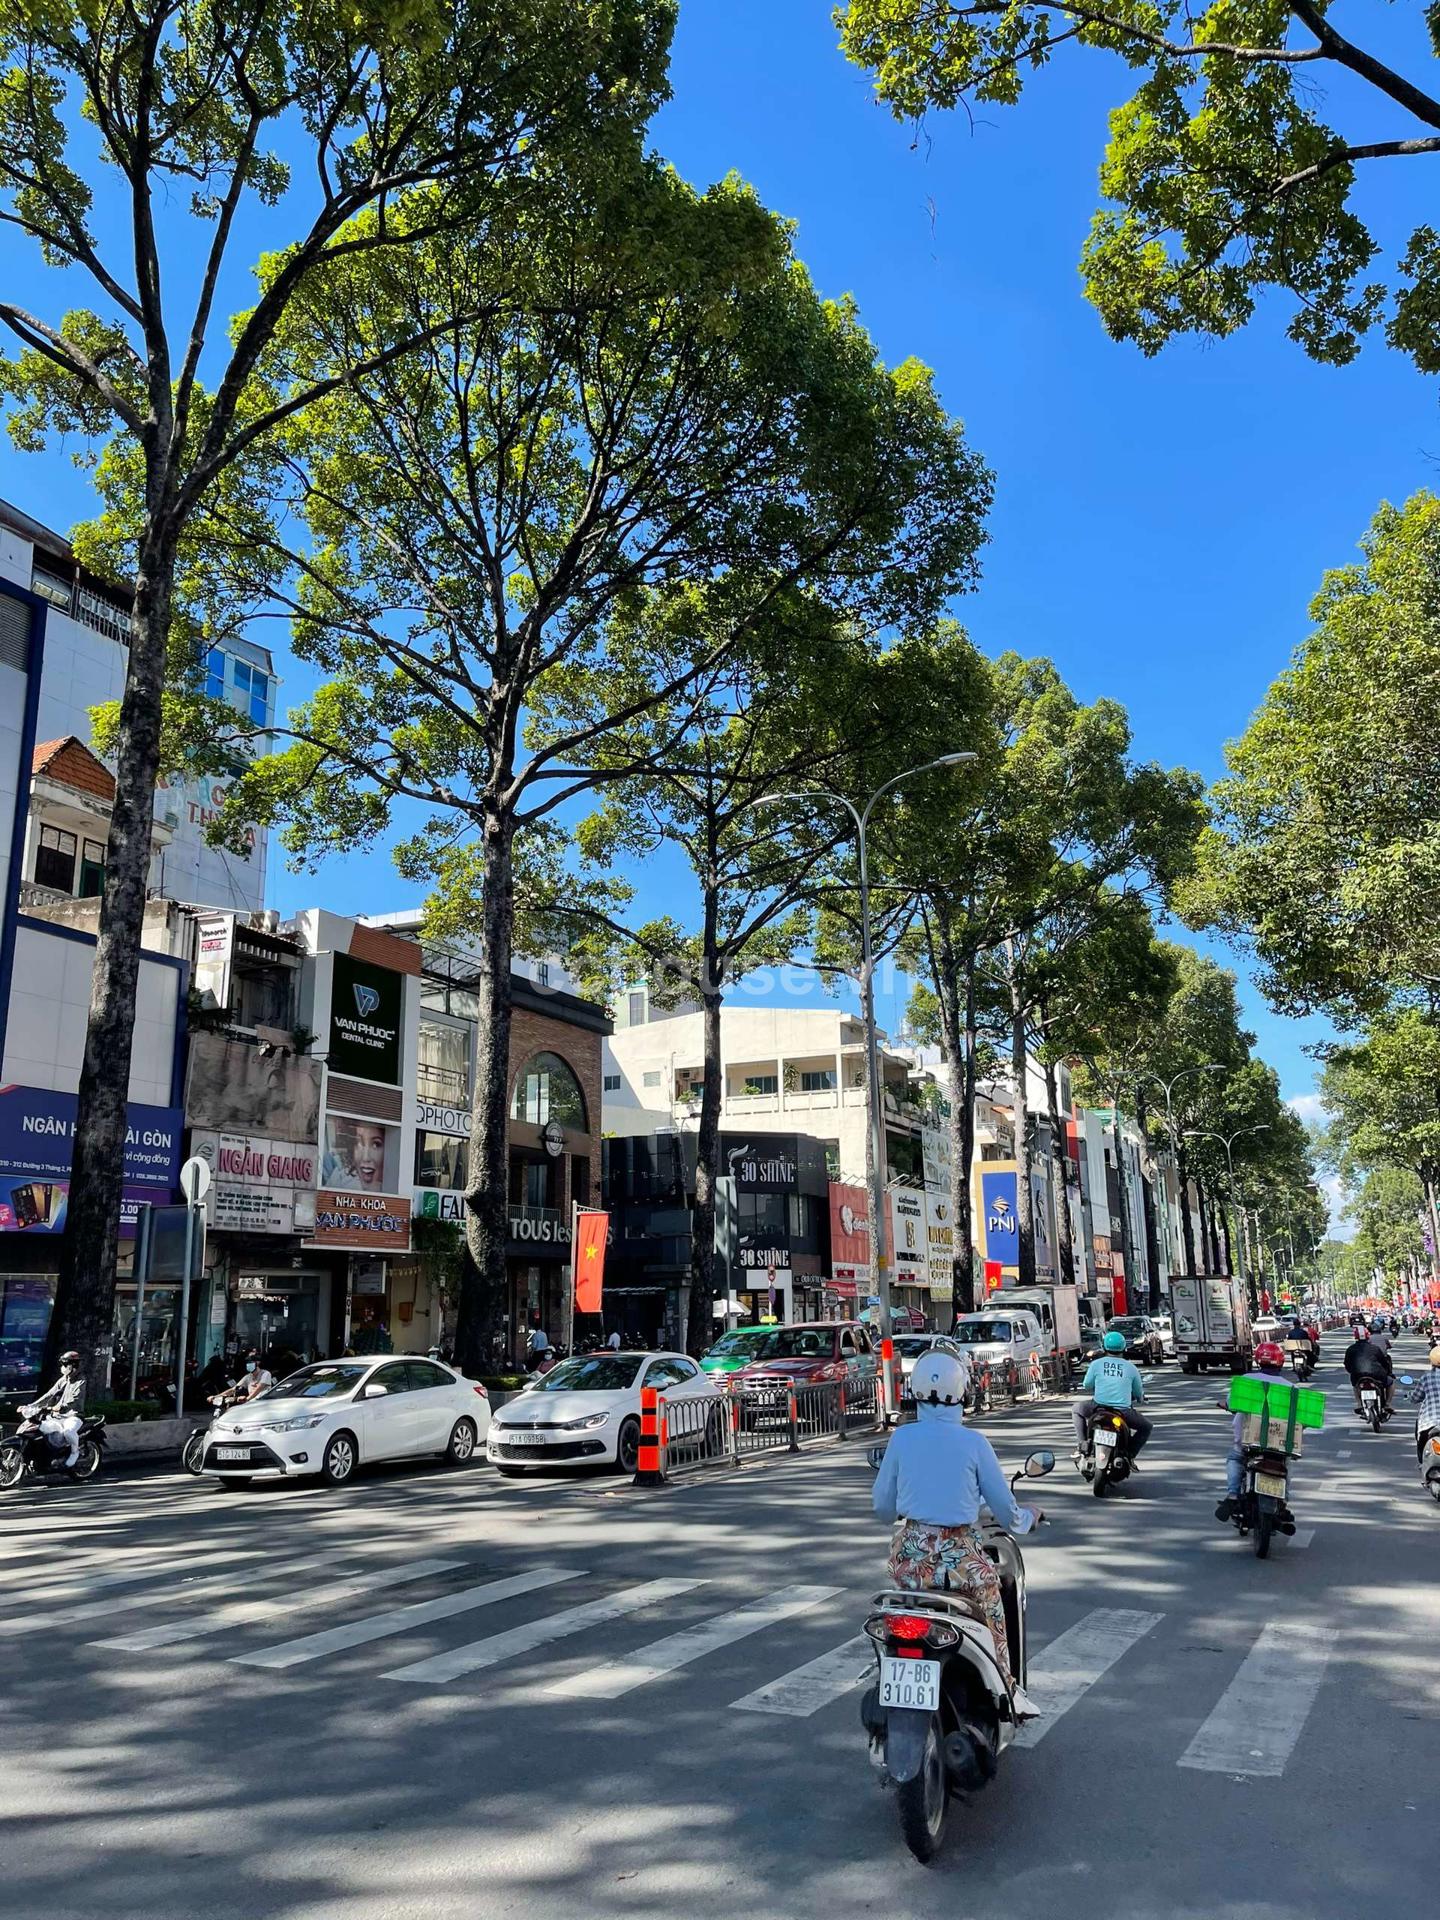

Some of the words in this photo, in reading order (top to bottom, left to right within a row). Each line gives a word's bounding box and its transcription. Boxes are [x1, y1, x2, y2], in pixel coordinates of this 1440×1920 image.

[335, 1016, 357, 1031] VAN
[341, 1032, 365, 1044] DENTAL
[366, 1038, 385, 1049] CLINIC
[23, 1115, 66, 1136] NGÂN
[125, 1126, 139, 1144] ÀI
[143, 1129, 172, 1148] GÒN
[133, 1152, 151, 1165] cộng
[152, 1153, 170, 1166] đồng
[267, 1154, 313, 1182] GIANG
[741, 1161, 757, 1183] 30
[760, 1161, 794, 1183] SHINE
[336, 1196, 356, 1208] NHA
[361, 1199, 386, 1211] KHOA
[510, 1218, 551, 1240] TOUS
[553, 1221, 572, 1243] les
[989, 1216, 1016, 1235] PNJ
[740, 1249, 755, 1267] 30
[757, 1249, 789, 1267] SHINE
[1104, 1361, 1123, 1370] BAE
[1104, 1369, 1123, 1378] MIN
[891, 1661, 931, 1684] 17-B6
[884, 1683, 935, 1707] 310.61
